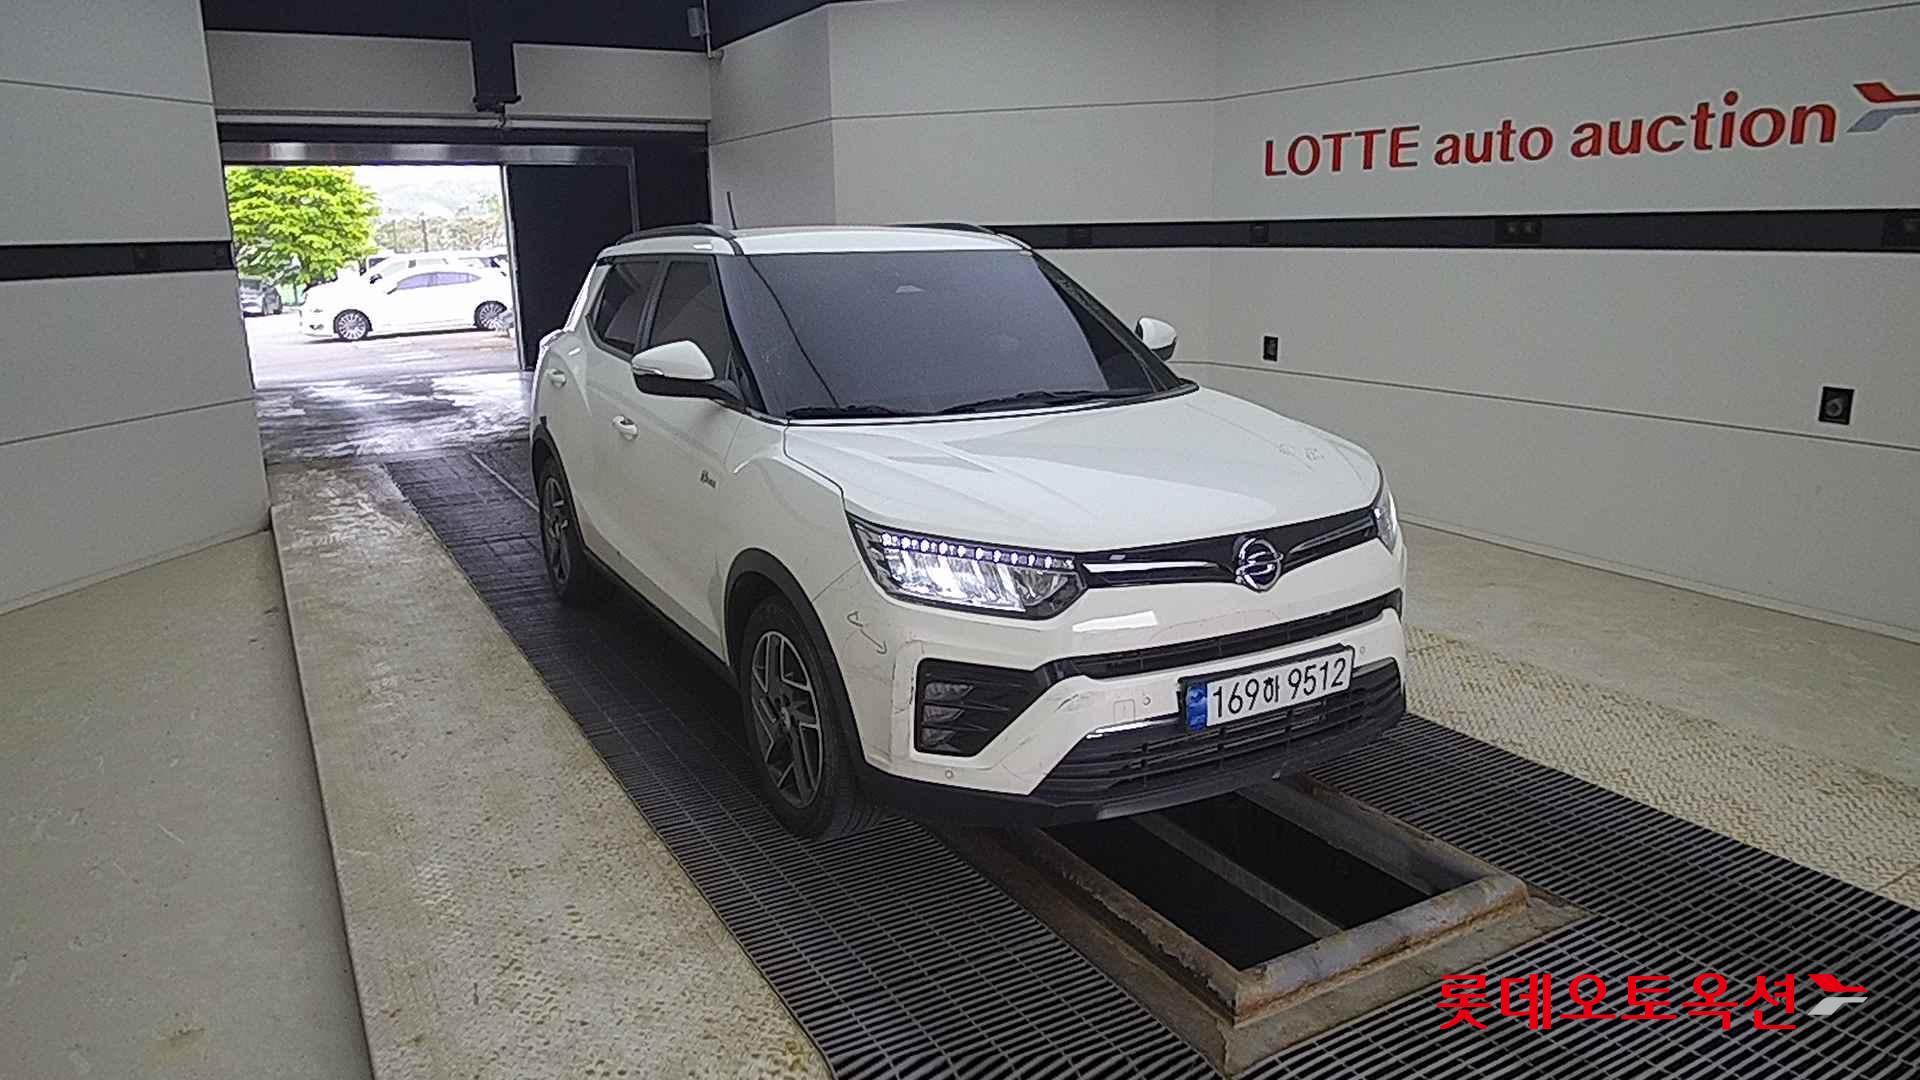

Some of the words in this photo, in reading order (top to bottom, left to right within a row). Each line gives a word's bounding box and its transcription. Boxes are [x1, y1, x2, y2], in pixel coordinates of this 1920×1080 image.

[1264, 125, 1421, 176] LOTTE
[1433, 119, 1553, 166] auto
[1570, 91, 1838, 158] auction
[1213, 675, 1280, 718] 169하
[1288, 657, 1346, 699] 9512
